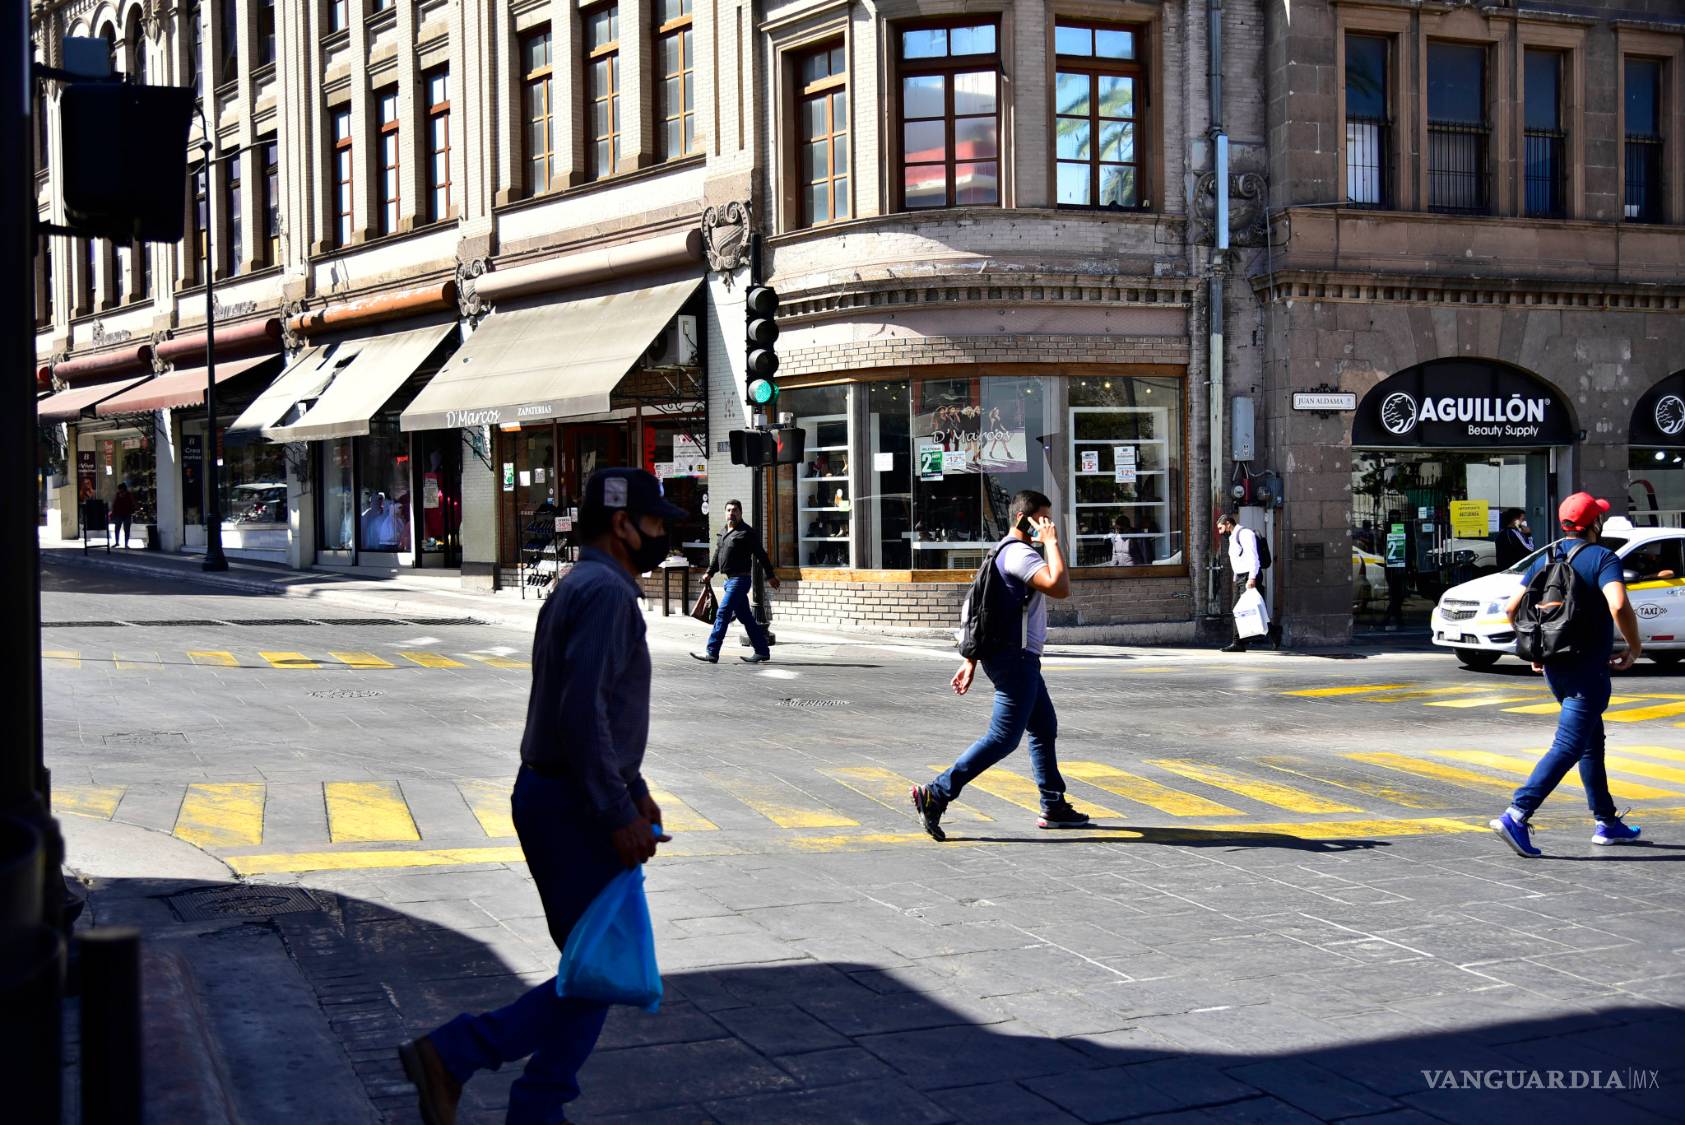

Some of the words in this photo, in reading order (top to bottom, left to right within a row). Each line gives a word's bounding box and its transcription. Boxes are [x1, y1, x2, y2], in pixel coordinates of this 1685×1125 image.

[1297, 397, 1315, 406] JUAN
[1317, 397, 1344, 405] ALDAMA
[446, 409, 500, 428] D'Marcos
[931, 428, 1011, 444] D'Marcos
[1468, 425, 1503, 437] Beauty
[1505, 425, 1539, 437] Supply
[1640, 607, 1658, 615] TAXI
